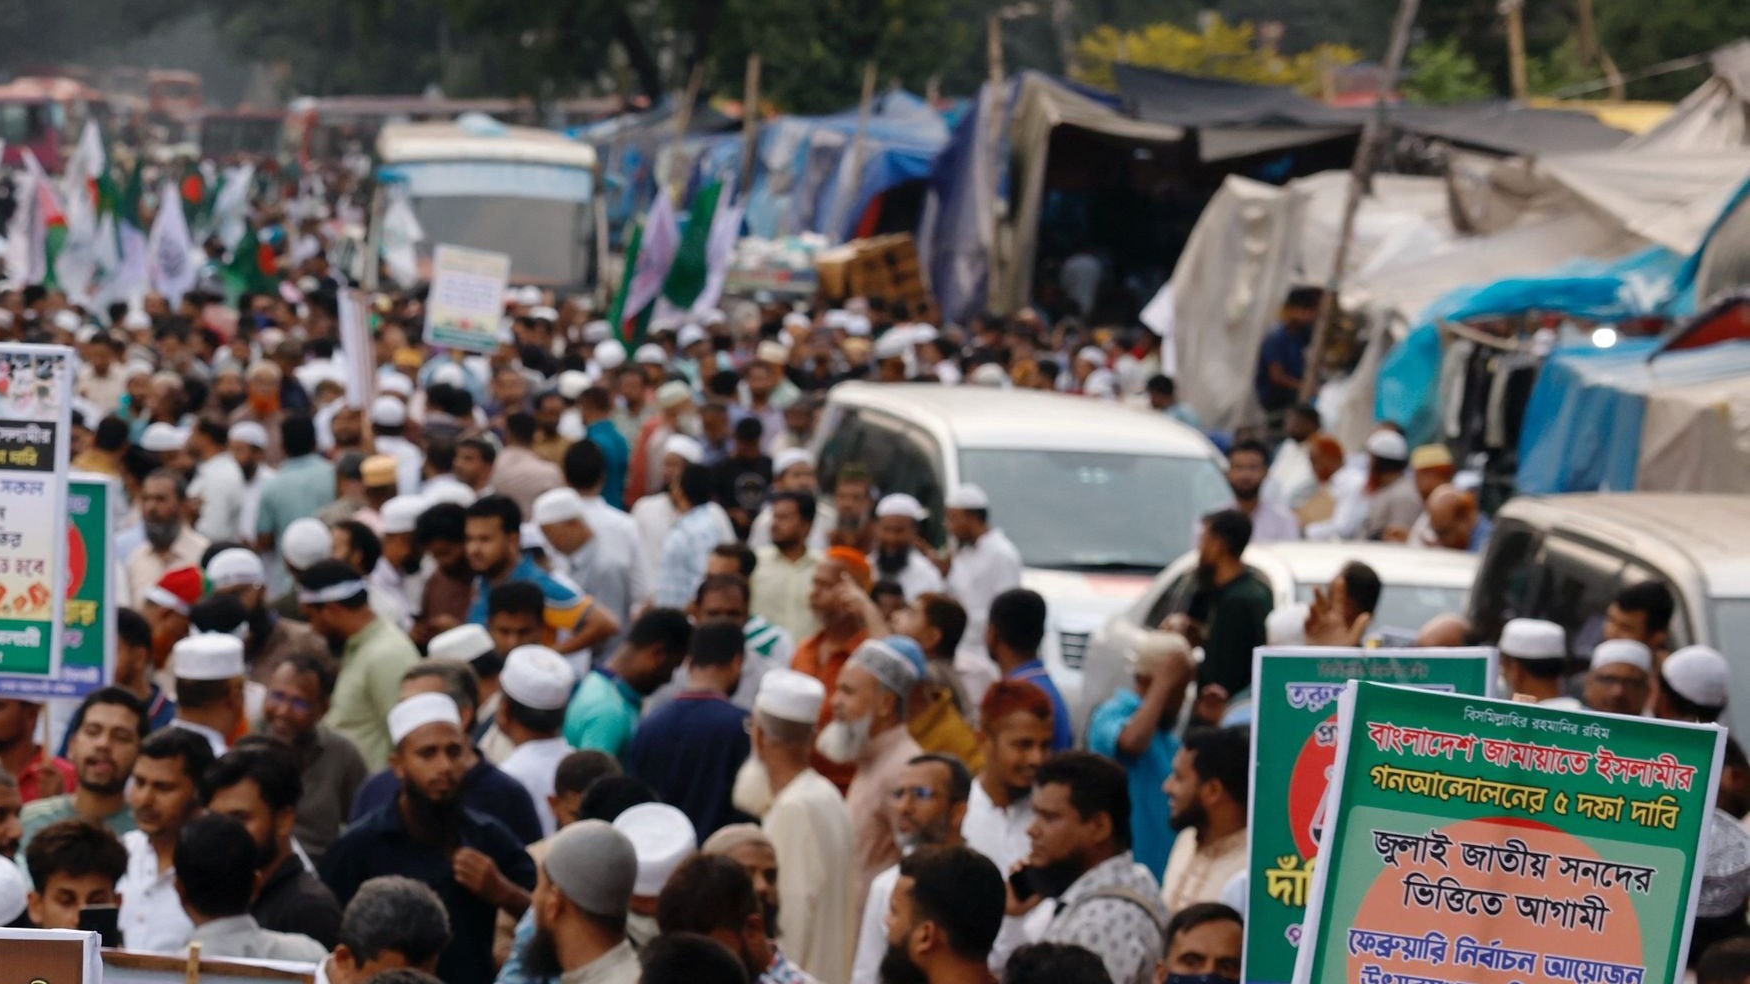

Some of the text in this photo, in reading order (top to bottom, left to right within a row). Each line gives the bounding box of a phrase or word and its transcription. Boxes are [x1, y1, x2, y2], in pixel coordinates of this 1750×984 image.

[1365, 720, 1475, 762] বাংলাদেশ
[1481, 737, 1588, 777] জামায়াতে
[1594, 746, 1694, 791] ইসলামীর
[1531, 718, 1579, 735] রহমানির
[1582, 724, 1610, 739] রহিম
[1369, 763, 1679, 829] গনআন্দোলনের ৫ দফা দাবি
[1373, 830, 1655, 893] জুলাই জাতীয় সনদের
[1403, 872, 1610, 931] ভিত্তিতে আগামী
[1348, 923, 1445, 964] ফেব্রুয়ারি
[1455, 935, 1536, 976] নির্বাচন
